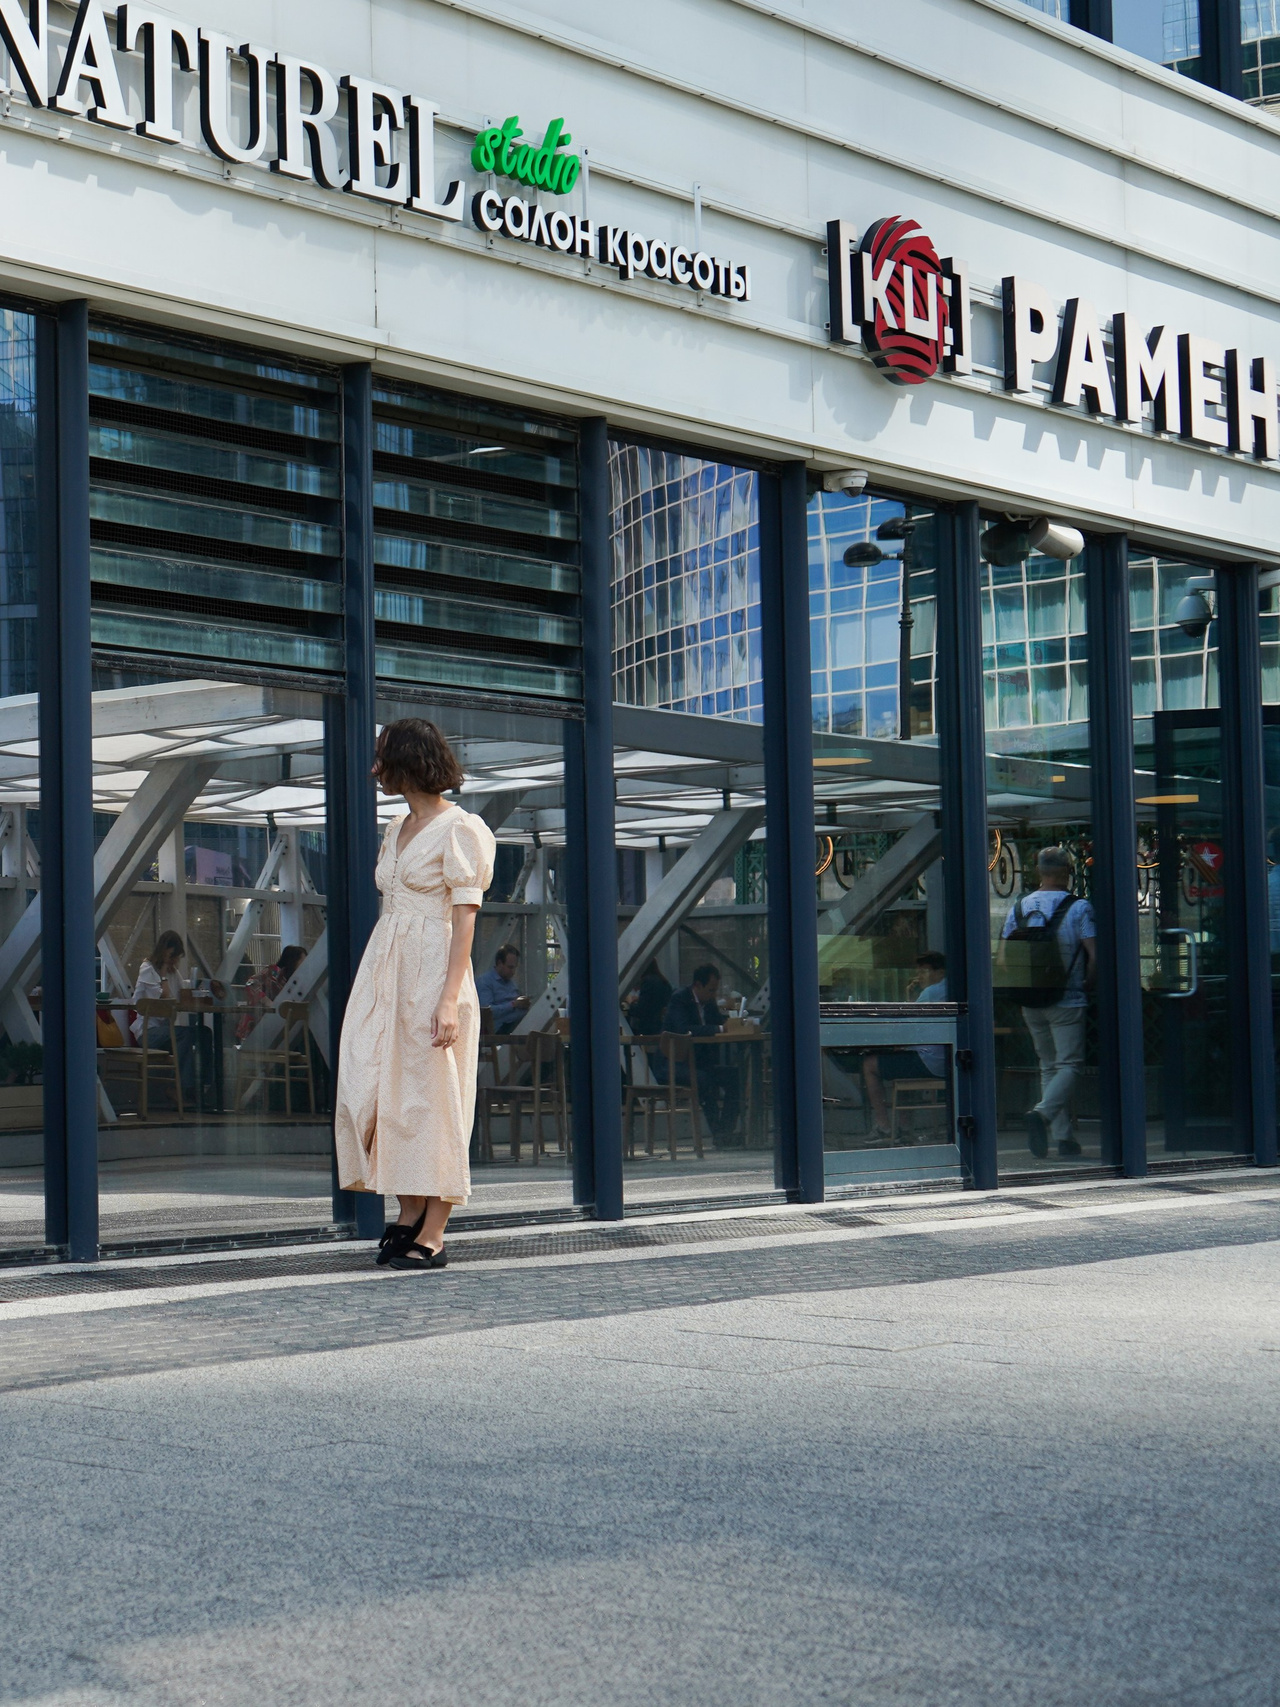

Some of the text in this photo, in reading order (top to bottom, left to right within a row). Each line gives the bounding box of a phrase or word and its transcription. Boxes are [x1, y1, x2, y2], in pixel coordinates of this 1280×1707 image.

[471, 115, 579, 195] studio
[472, 189, 752, 302] салон красоты
[1001, 276, 1280, 462] РАМЕН
